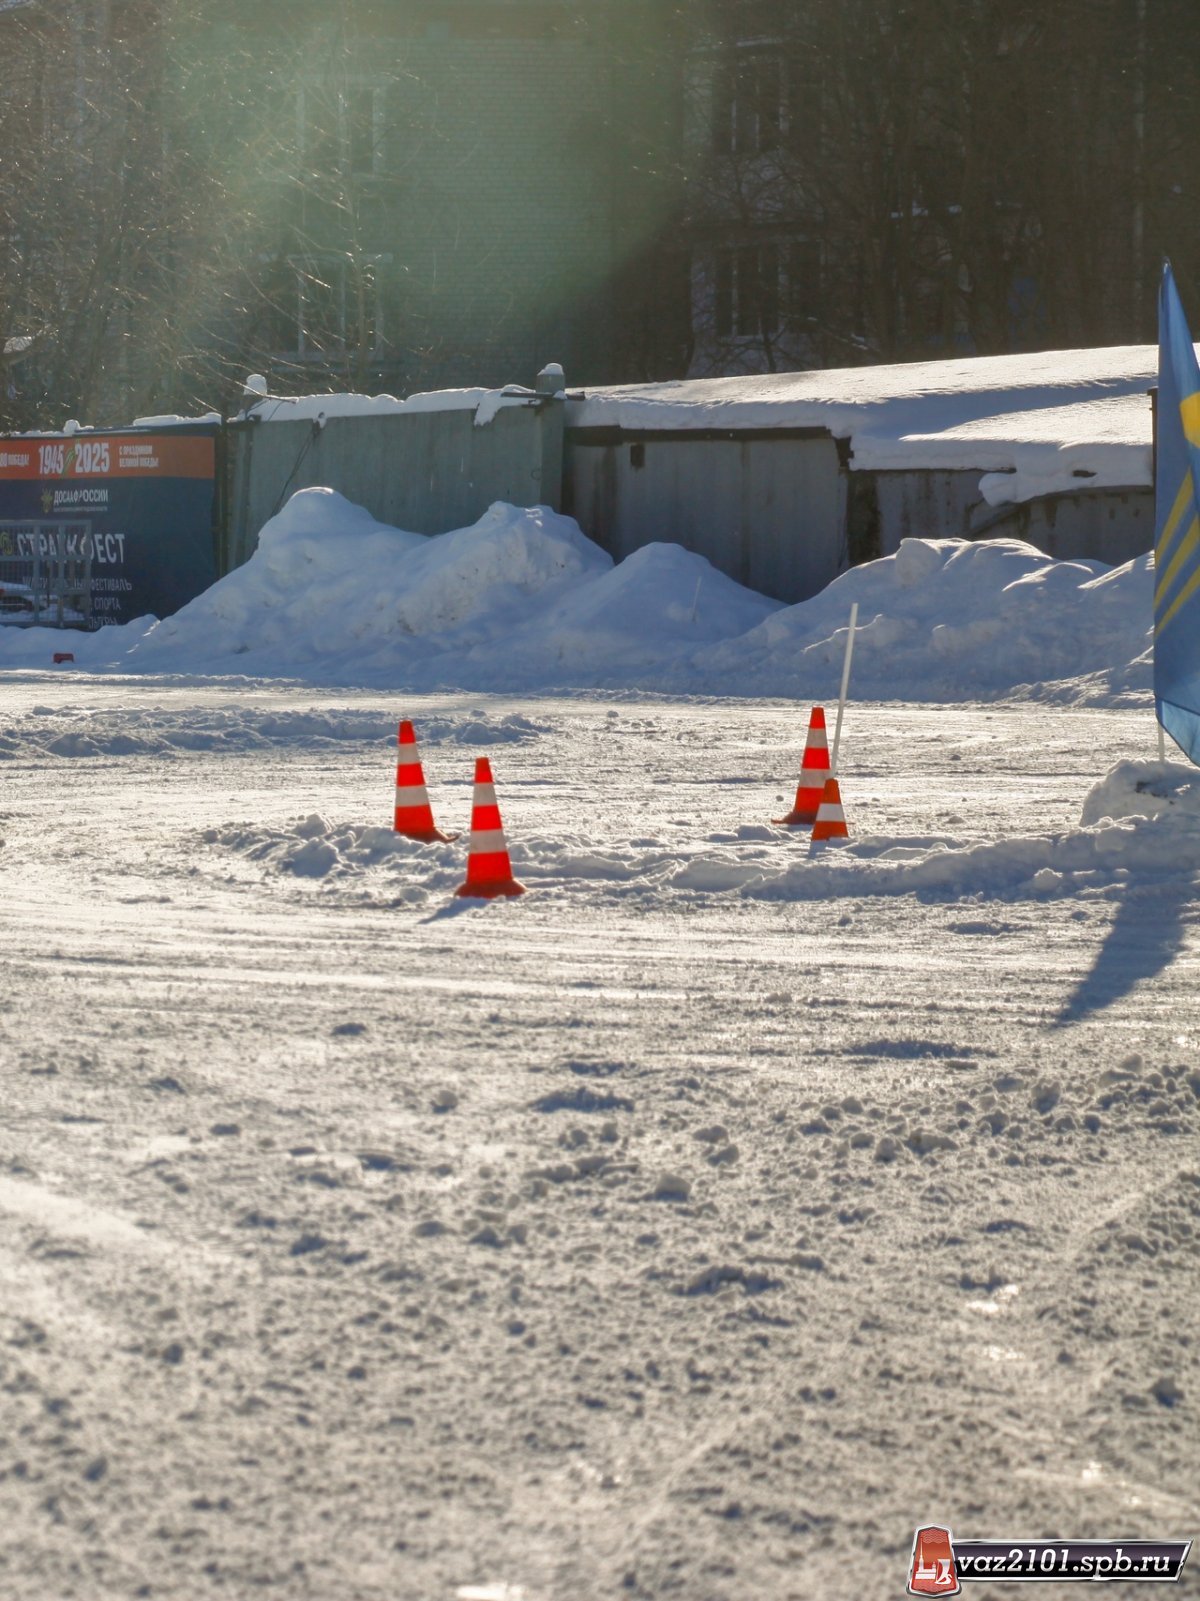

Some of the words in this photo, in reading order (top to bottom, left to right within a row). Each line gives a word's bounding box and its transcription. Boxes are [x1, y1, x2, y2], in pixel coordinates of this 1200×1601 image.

[38, 444, 64, 474] 1945
[75, 442, 110, 473] 2025
[94, 597, 121, 611] СПОРТА
